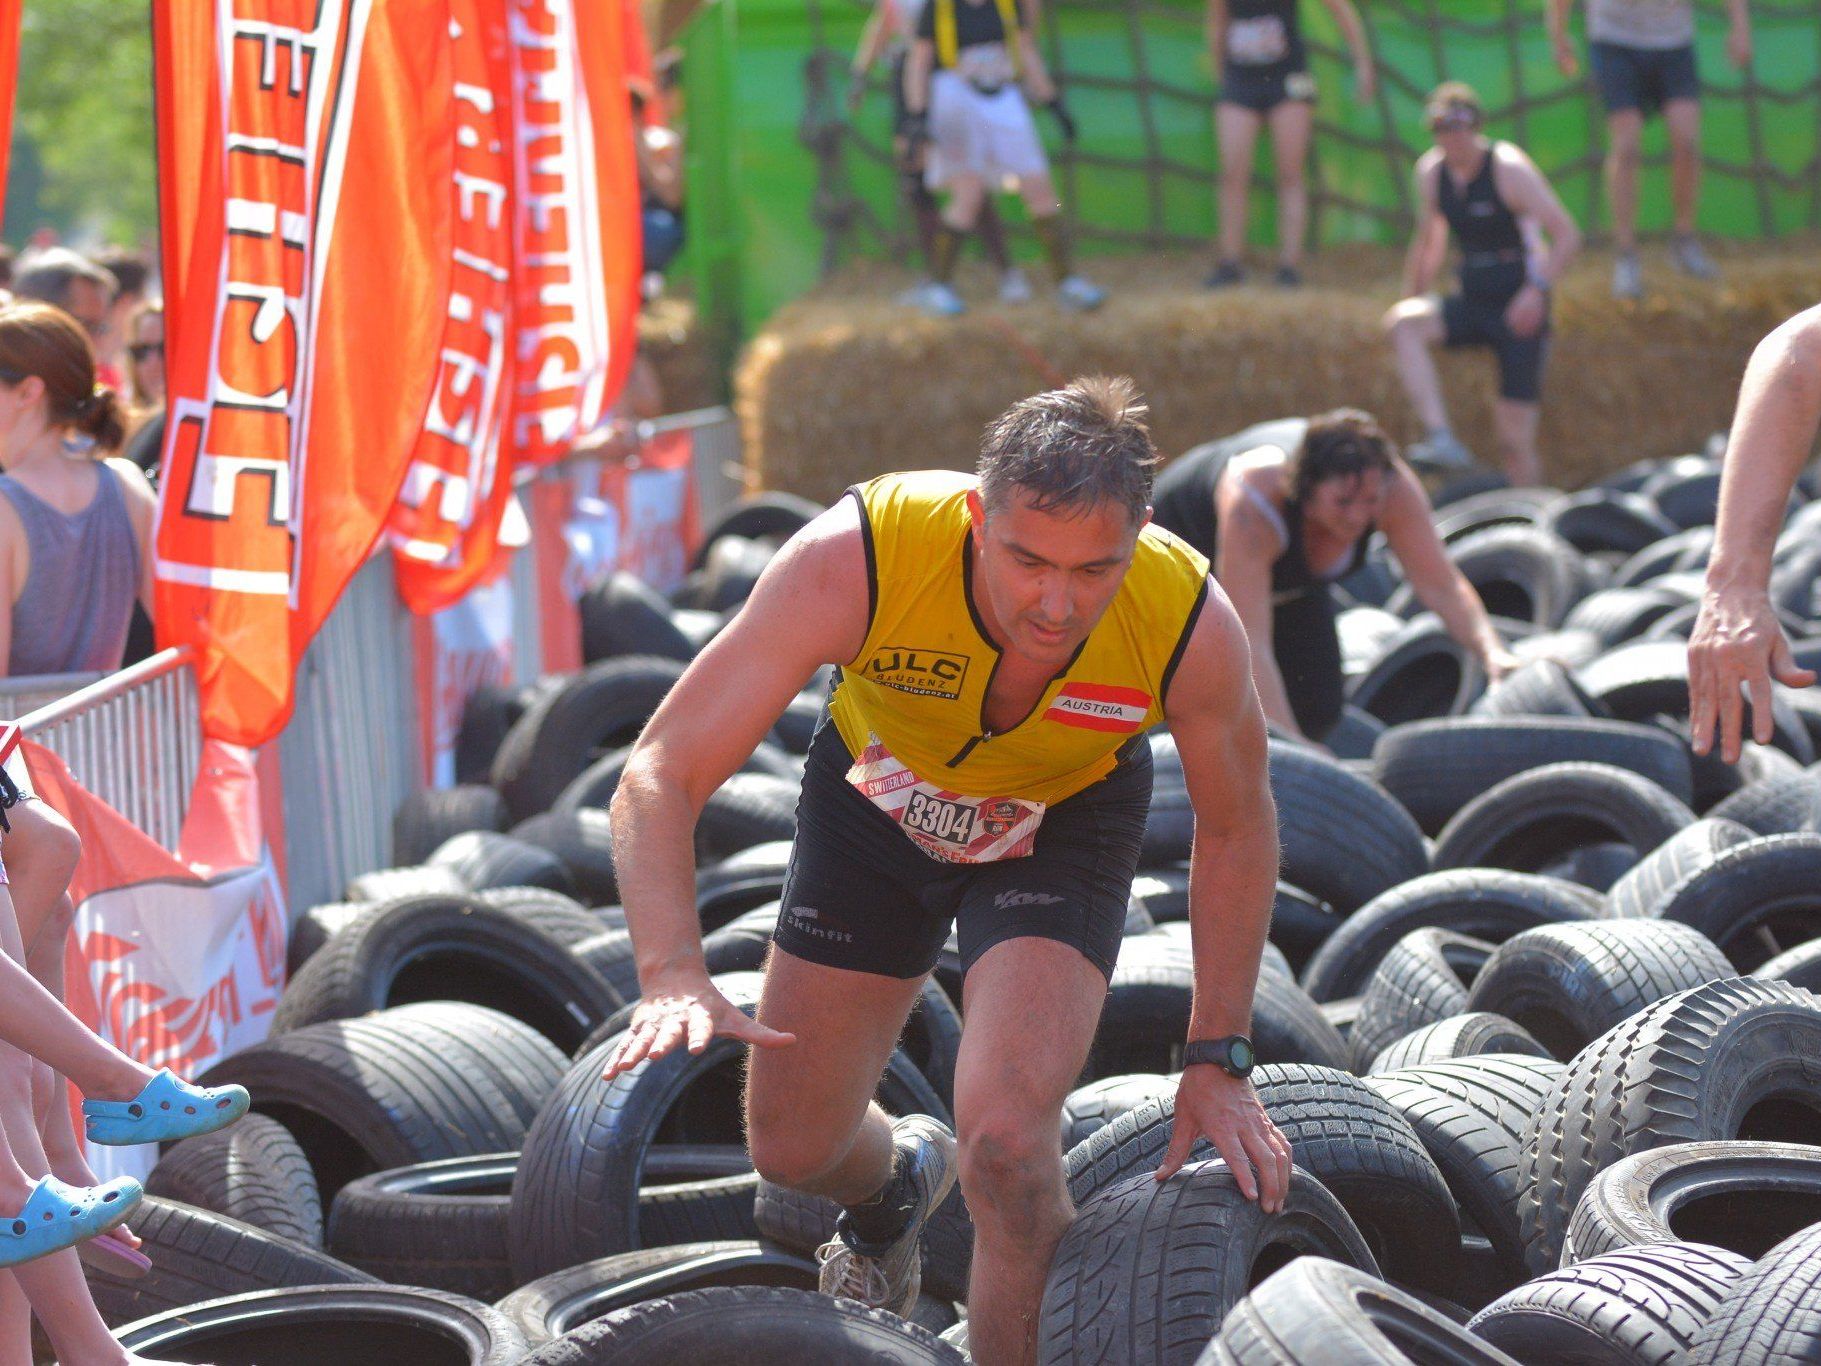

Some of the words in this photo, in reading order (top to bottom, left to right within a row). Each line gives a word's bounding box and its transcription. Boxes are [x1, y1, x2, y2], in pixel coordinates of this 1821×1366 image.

[158, 0, 322, 582] FISHE
[873, 652, 962, 681] ULC
[876, 673, 947, 689] BLUDENZ
[1062, 699, 1124, 717] AUSTRIA
[907, 794, 973, 842] 3304
